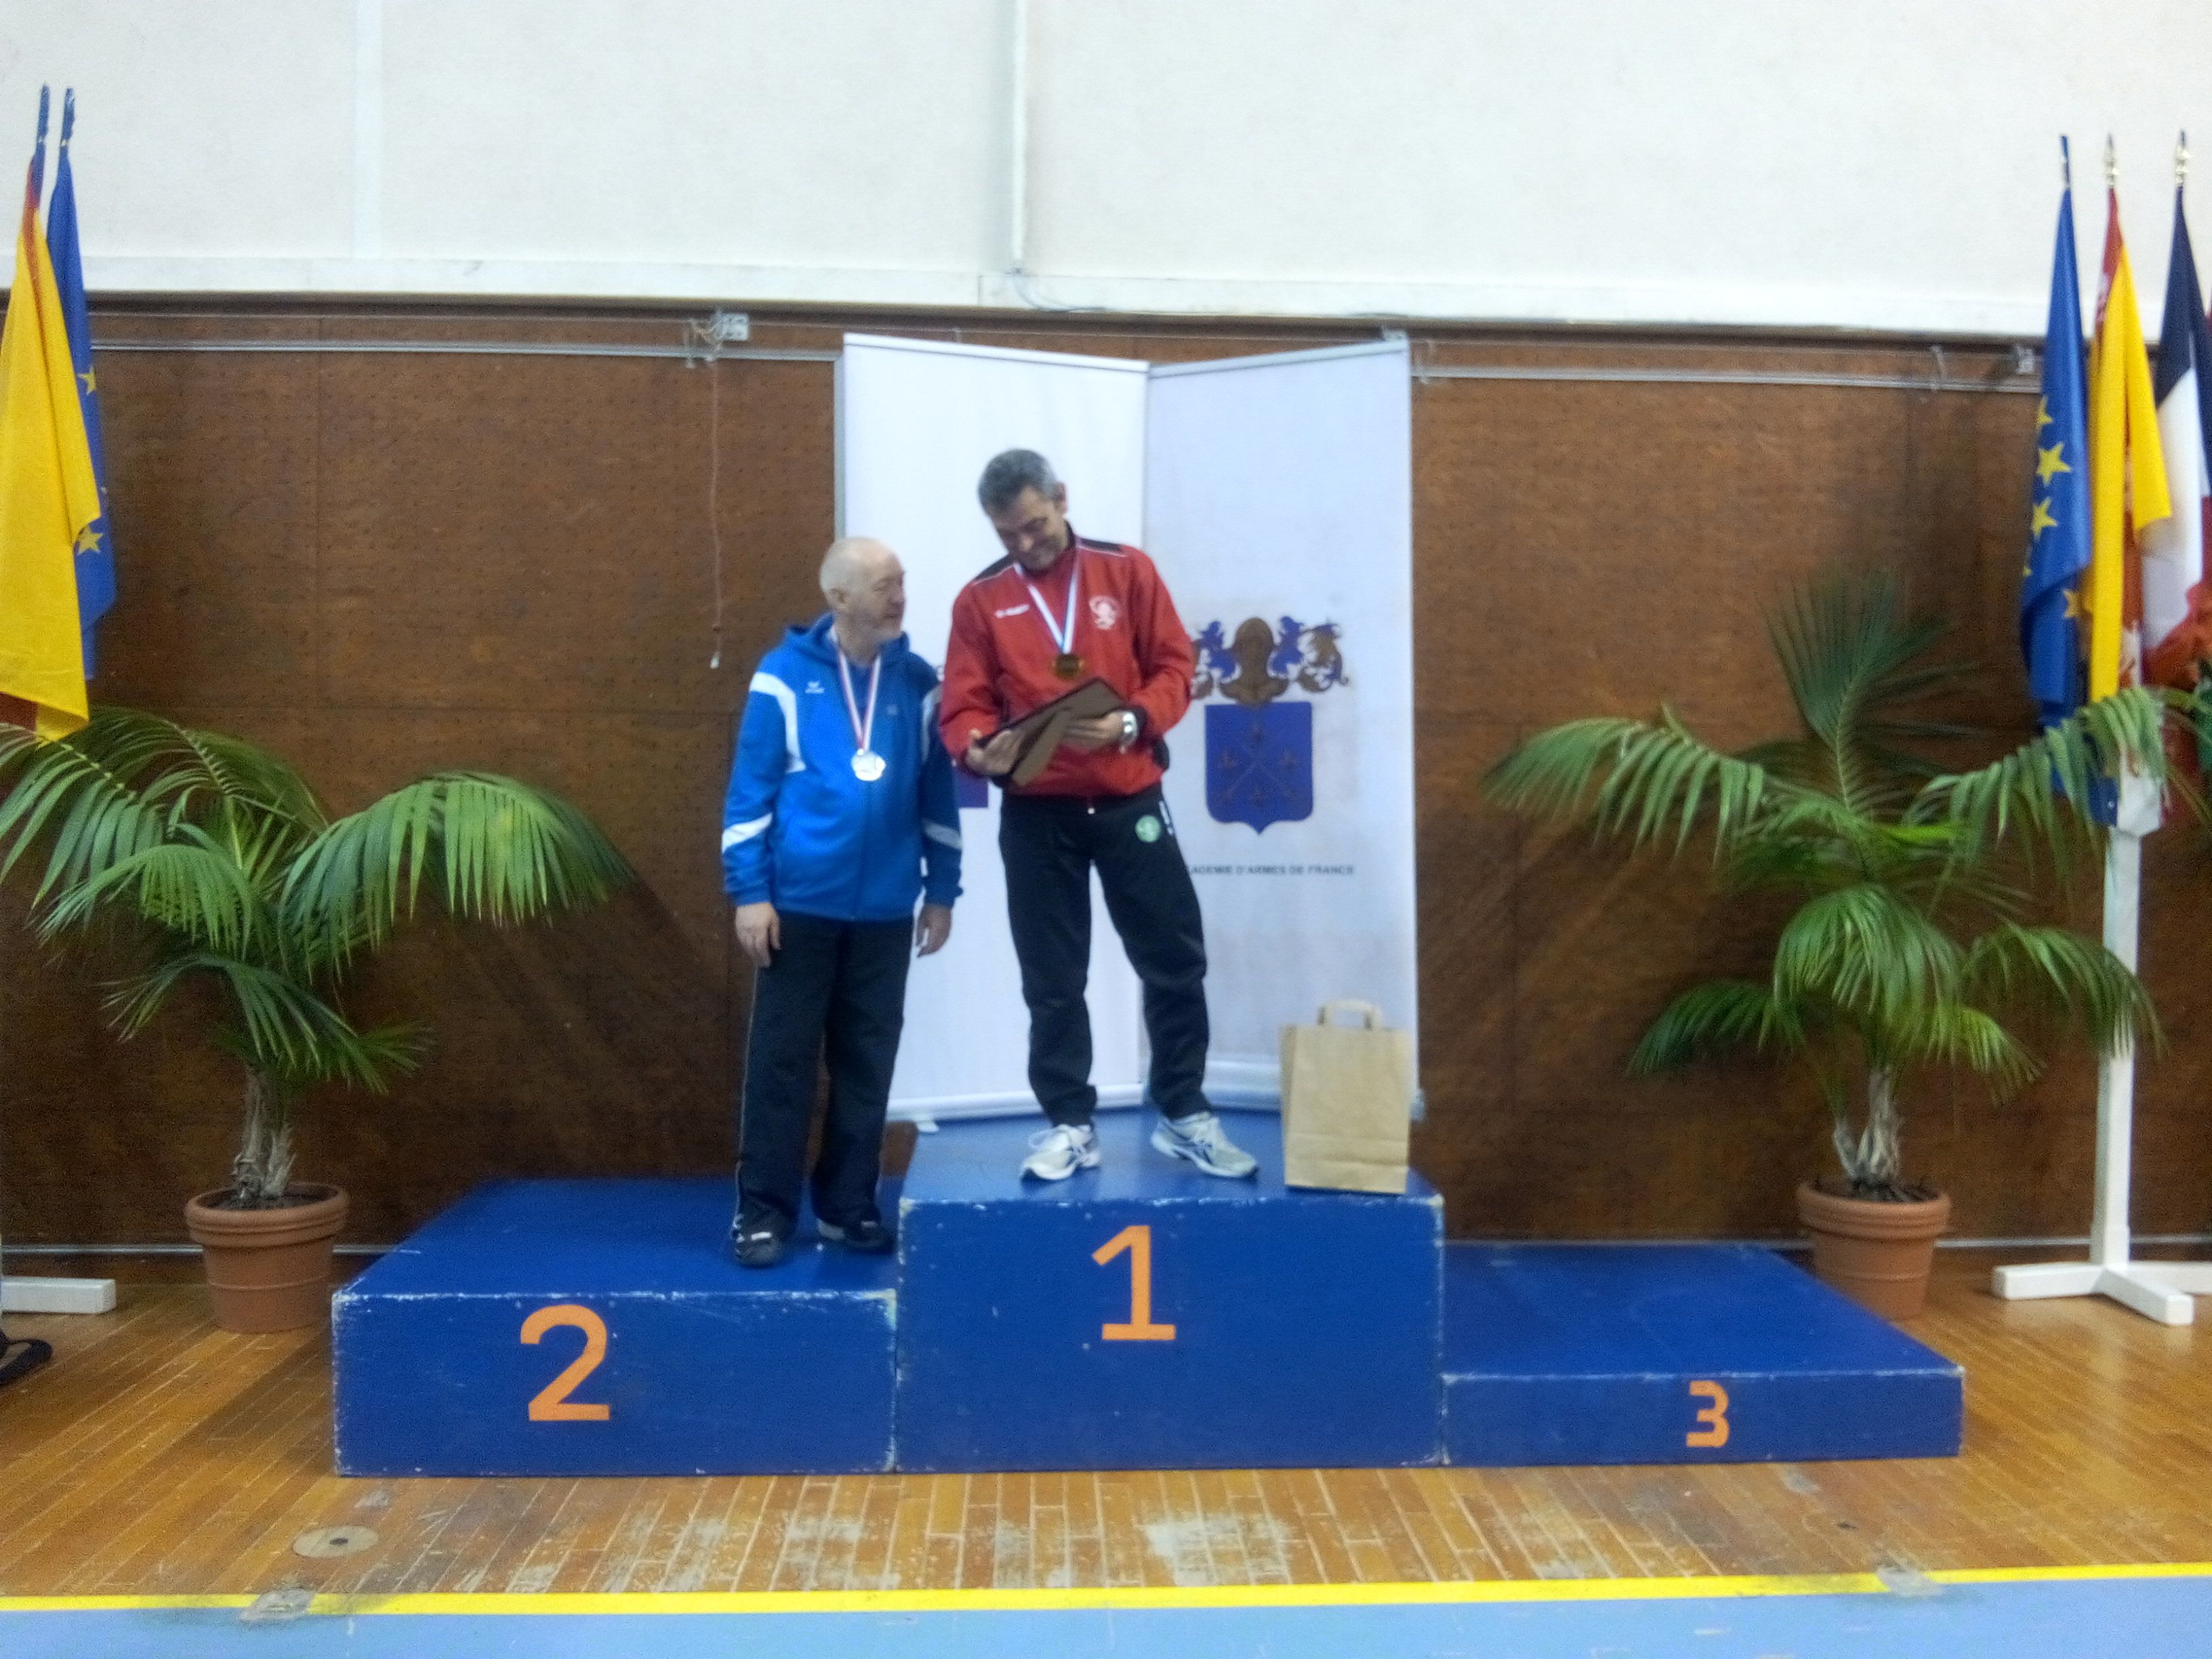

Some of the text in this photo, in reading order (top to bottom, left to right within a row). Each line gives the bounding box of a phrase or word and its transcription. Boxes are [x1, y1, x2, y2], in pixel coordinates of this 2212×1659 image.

[1289, 864, 1304, 875] DE
[1307, 864, 1354, 875] FRANCE
[1092, 1225, 1175, 1340] 1
[520, 1305, 610, 1421] 2
[1686, 1380, 1729, 1448] 3
